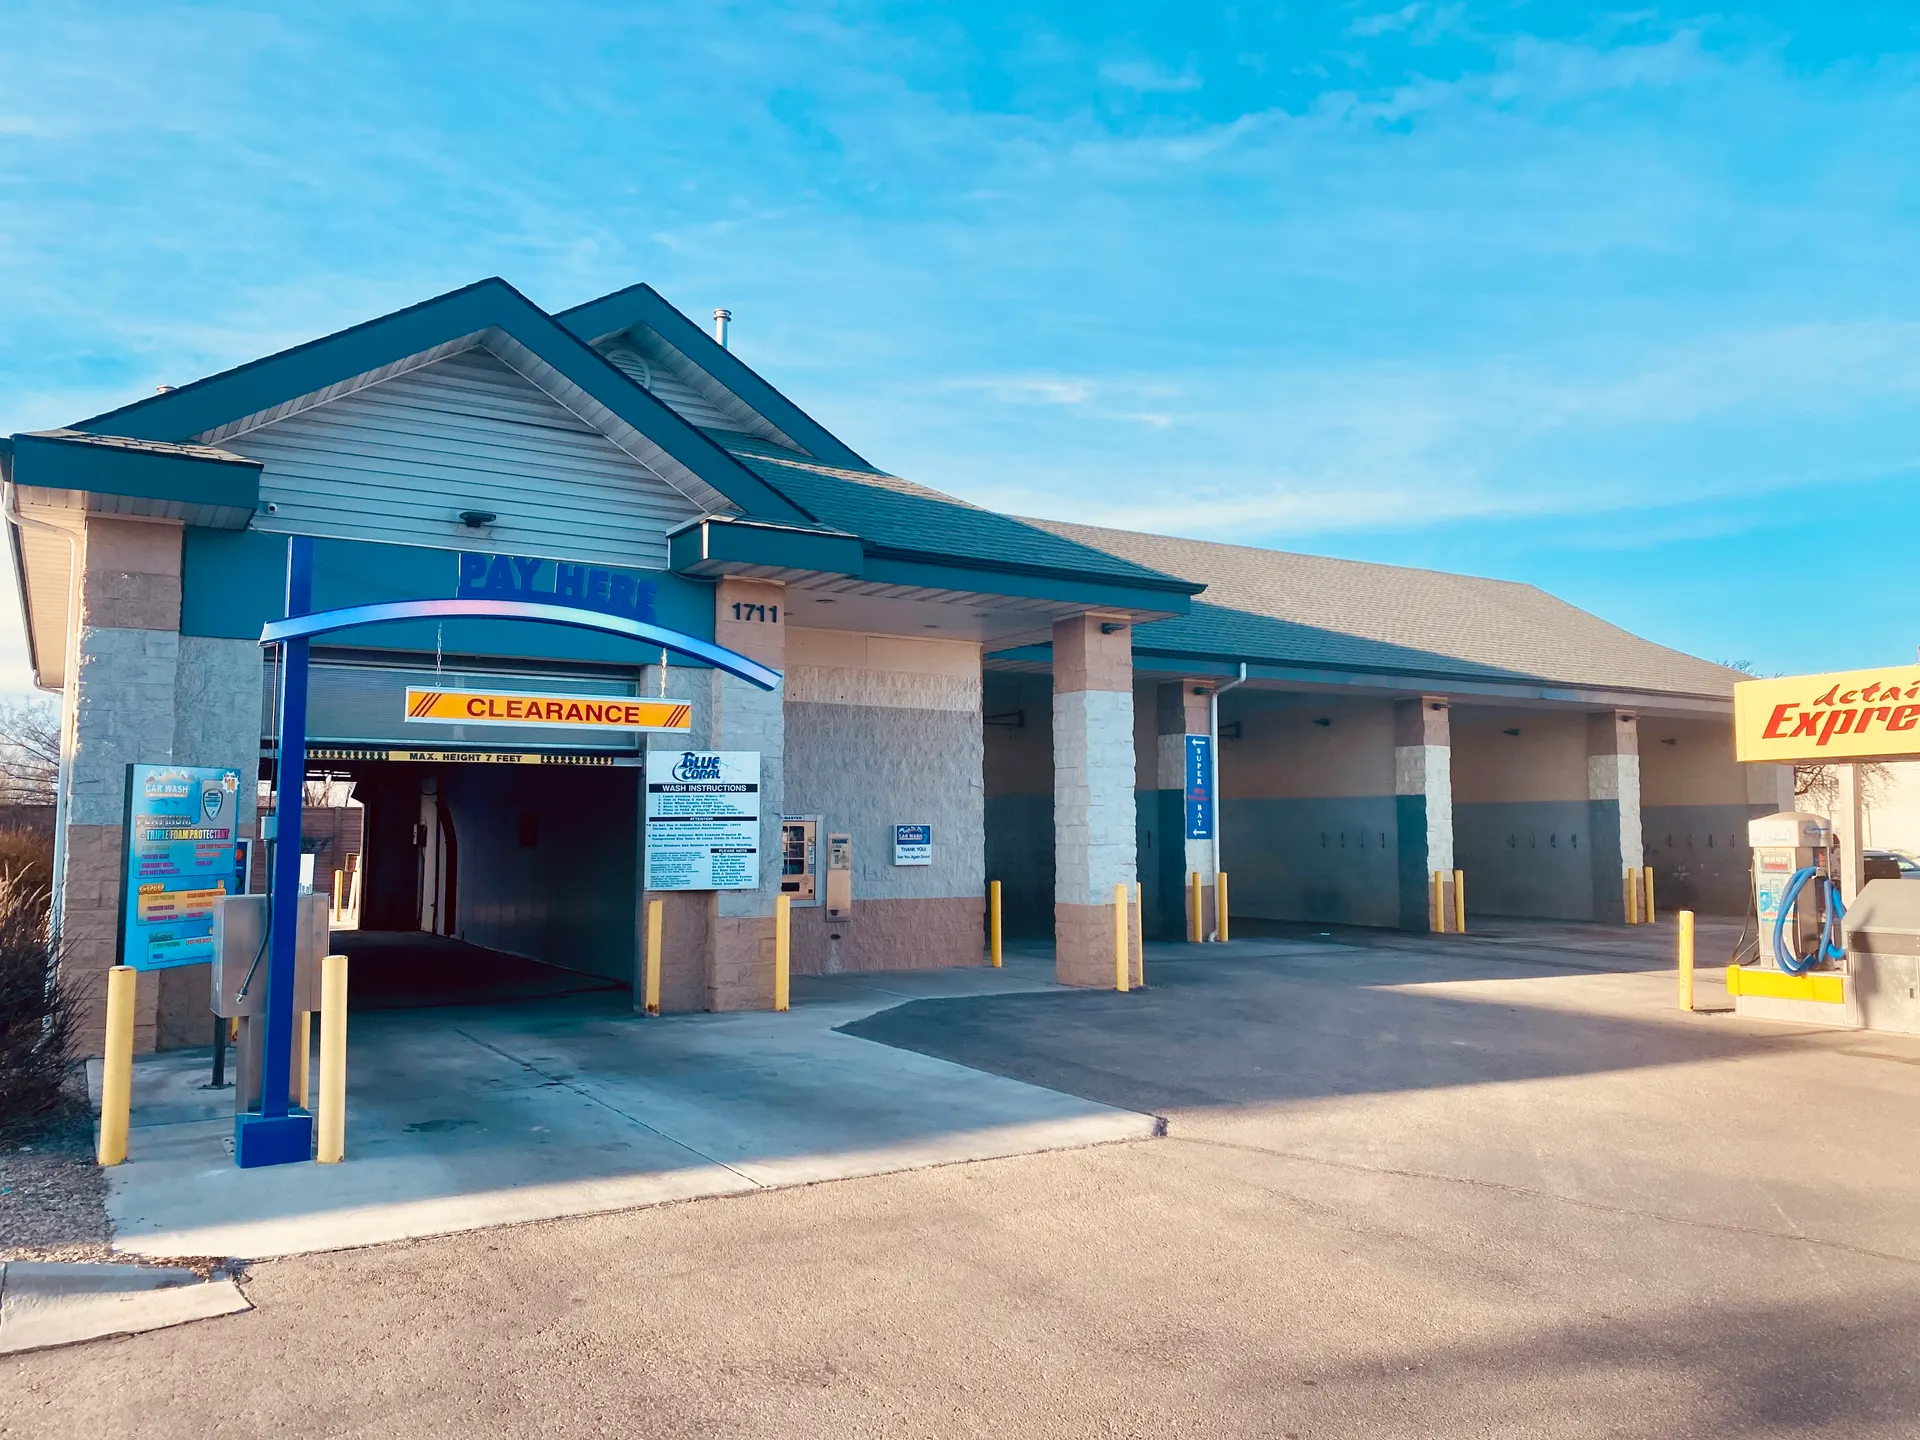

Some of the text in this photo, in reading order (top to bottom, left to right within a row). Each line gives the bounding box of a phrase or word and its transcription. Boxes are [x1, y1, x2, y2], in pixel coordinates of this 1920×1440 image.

[459, 552, 658, 608] PAY HERE
[732, 602, 778, 623] 1711
[466, 698, 640, 724] CLEARANCE
[409, 752, 522, 763] MAX. HEIGHT 7 FEET
[145, 785, 188, 794] CAR WASH
[662, 784, 747, 792] WASH INSTRUCTIONS
[145, 829, 170, 840] TRIPLE
[170, 829, 189, 840] FOAM
